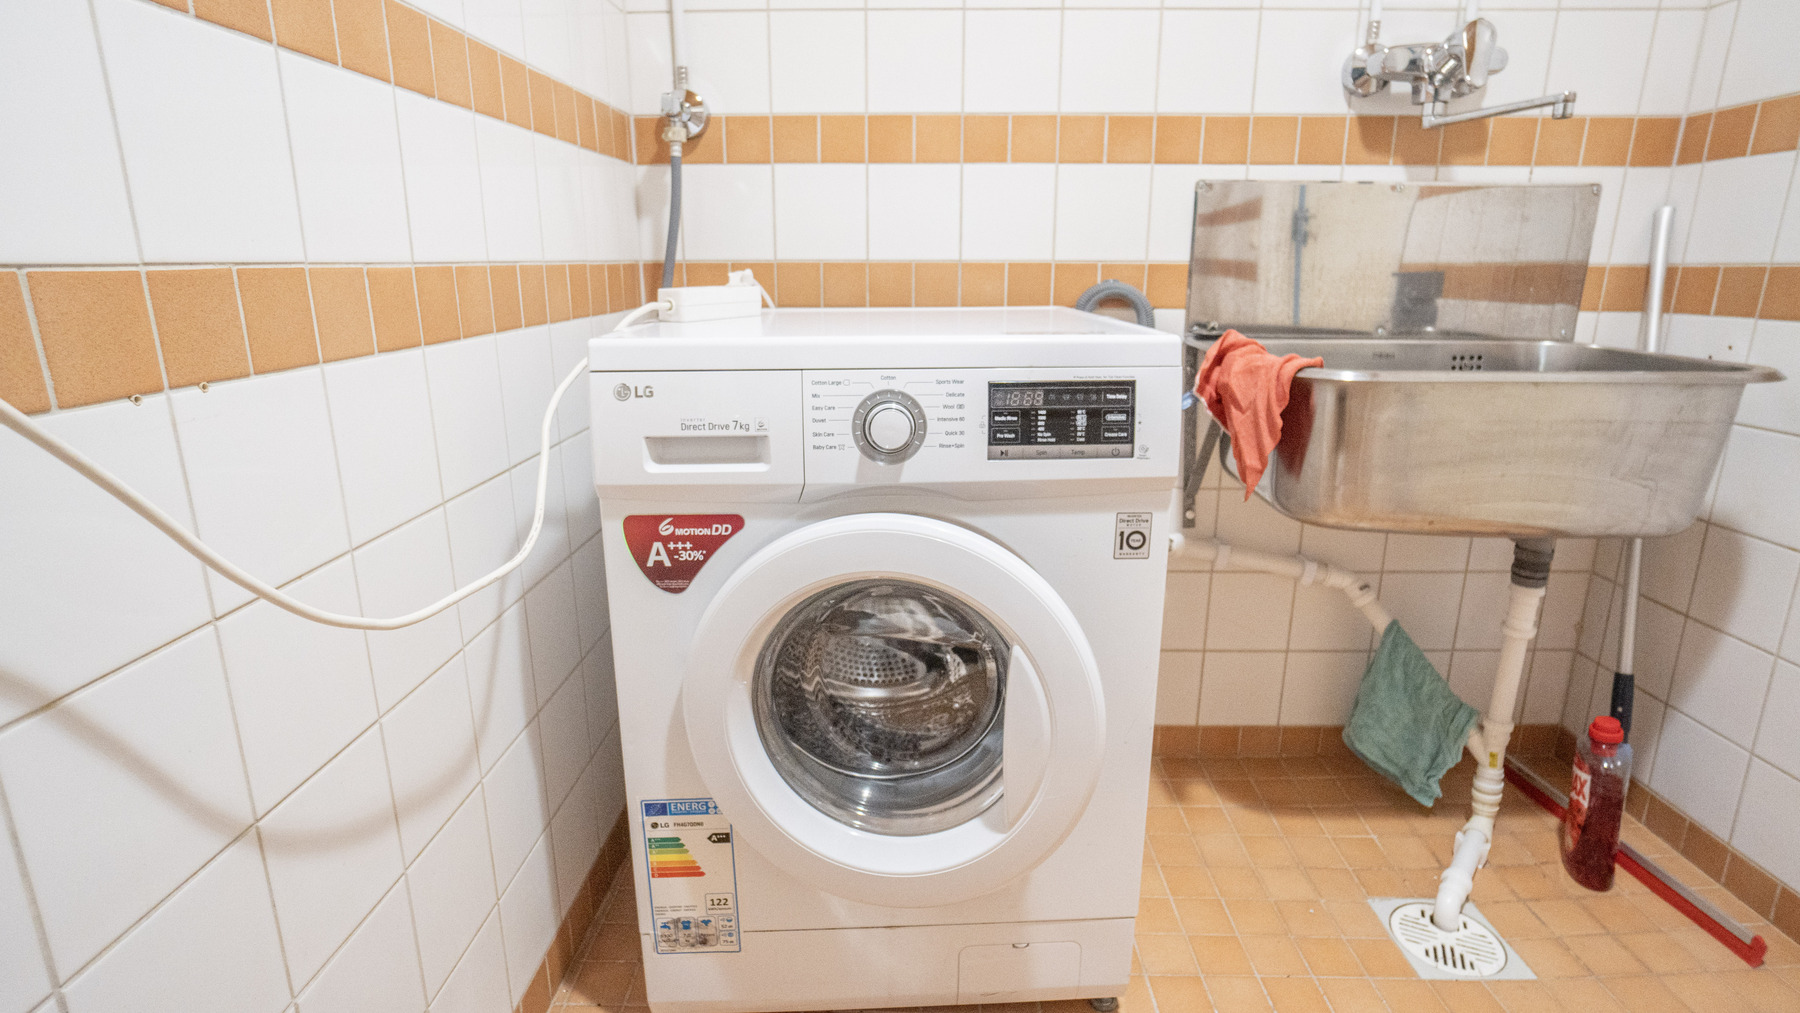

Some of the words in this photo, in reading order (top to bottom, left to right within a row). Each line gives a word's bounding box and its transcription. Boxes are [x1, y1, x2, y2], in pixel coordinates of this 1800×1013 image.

[634, 385, 654, 398] LG
[680, 422, 706, 431] Direct
[708, 422, 730, 431] Drive
[675, 528, 711, 536] MOTION
[1119, 530, 1146, 550] 10
[670, 802, 707, 812] ENERG
[710, 898, 729, 906] 122
